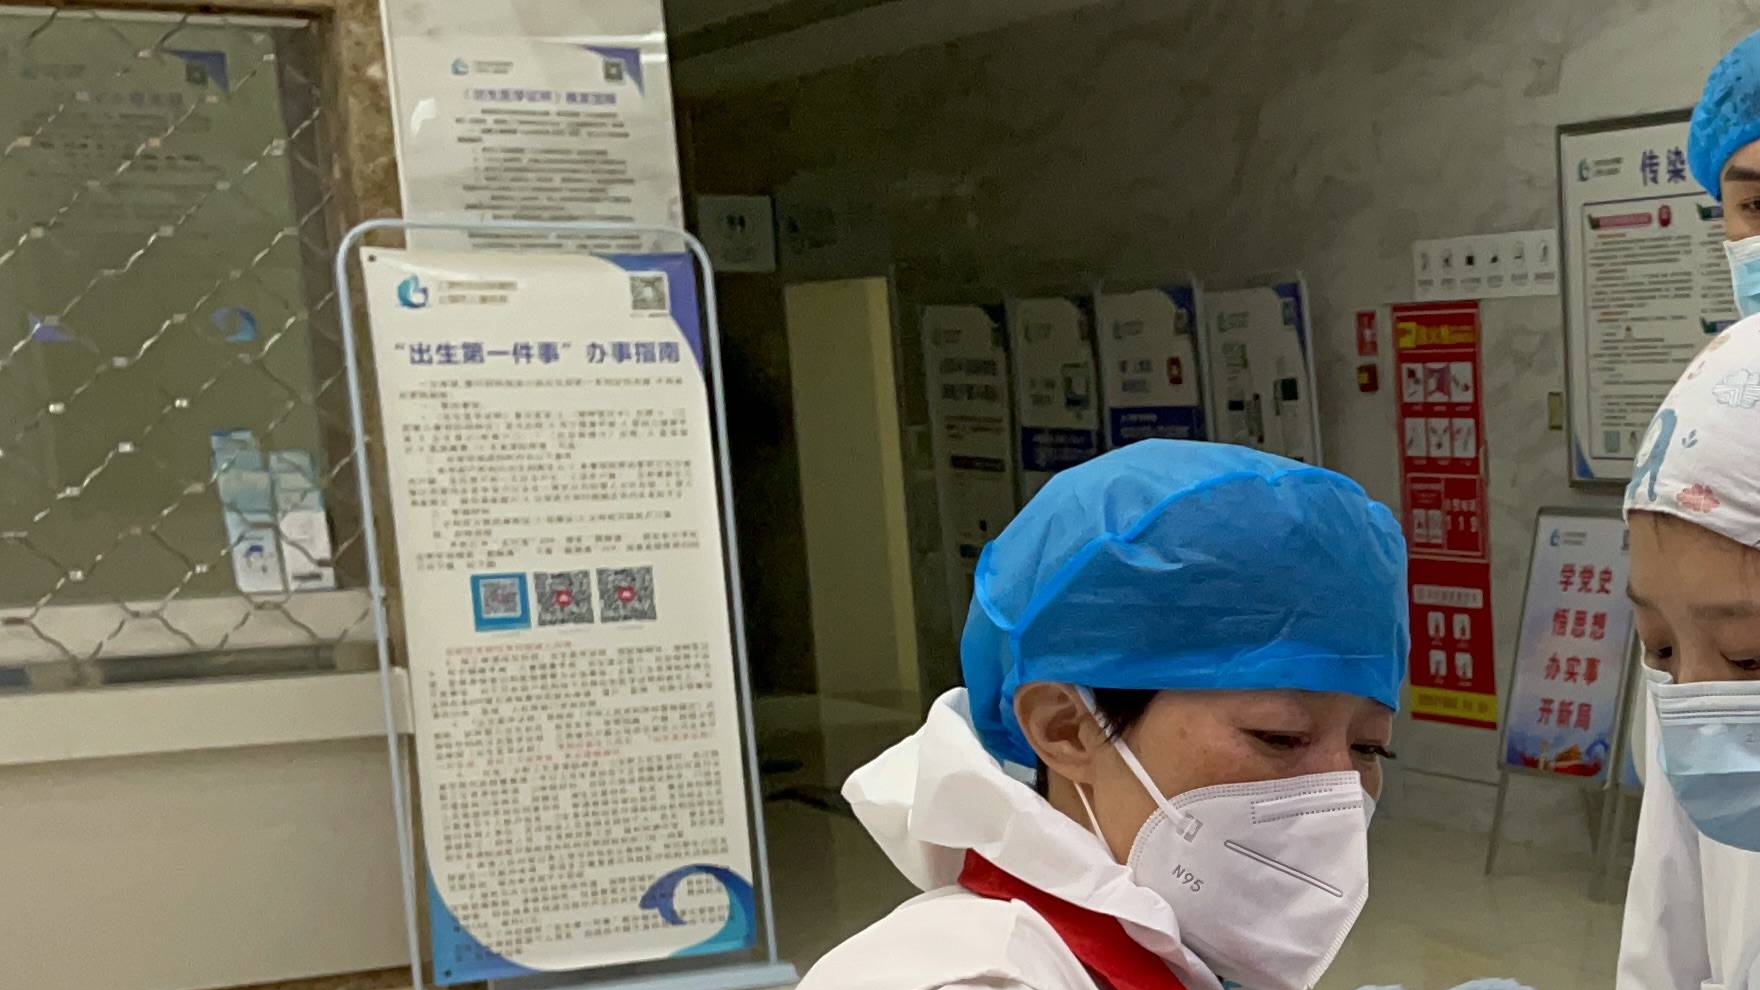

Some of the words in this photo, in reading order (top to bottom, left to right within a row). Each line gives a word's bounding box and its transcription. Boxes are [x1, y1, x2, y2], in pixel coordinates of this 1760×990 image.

[1640, 146, 1688, 187] 传染
[1559, 563, 1613, 595] 学党史
[1551, 608, 1607, 641] 悟思想
[1544, 652, 1601, 685] 办实事
[1536, 697, 1592, 731] 开新局
[1171, 863, 1205, 894] N95
